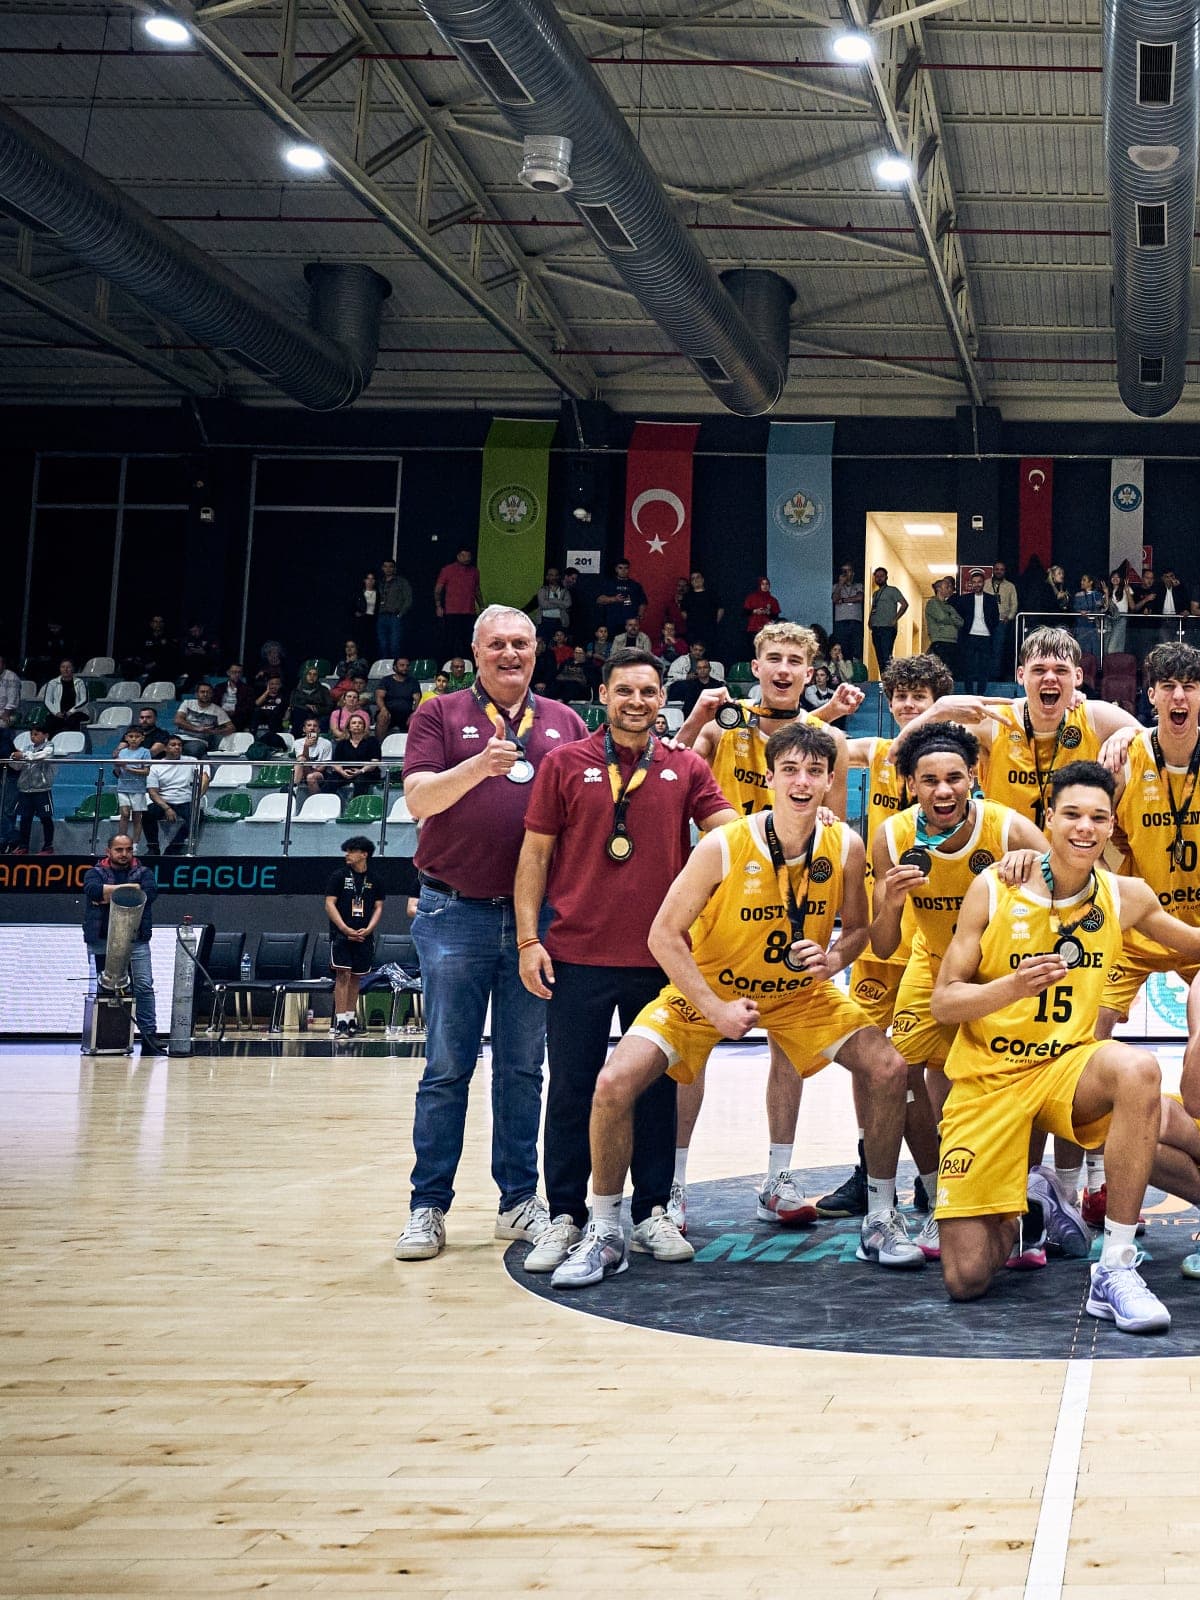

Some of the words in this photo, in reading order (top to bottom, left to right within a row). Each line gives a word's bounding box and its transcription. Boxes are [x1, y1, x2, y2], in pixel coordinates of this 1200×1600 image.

[574, 557, 592, 566] 201
[1165, 840, 1198, 873] 10
[154, 865, 278, 889] LEAGUE
[740, 900, 827, 922] OOSTDE
[763, 930, 788, 964] 8
[718, 968, 814, 993] Coretec
[858, 983, 885, 1001] P&V
[1034, 985, 1074, 1024] 15
[990, 1036, 1083, 1058] Corete
[942, 1158, 974, 1175] P&V
